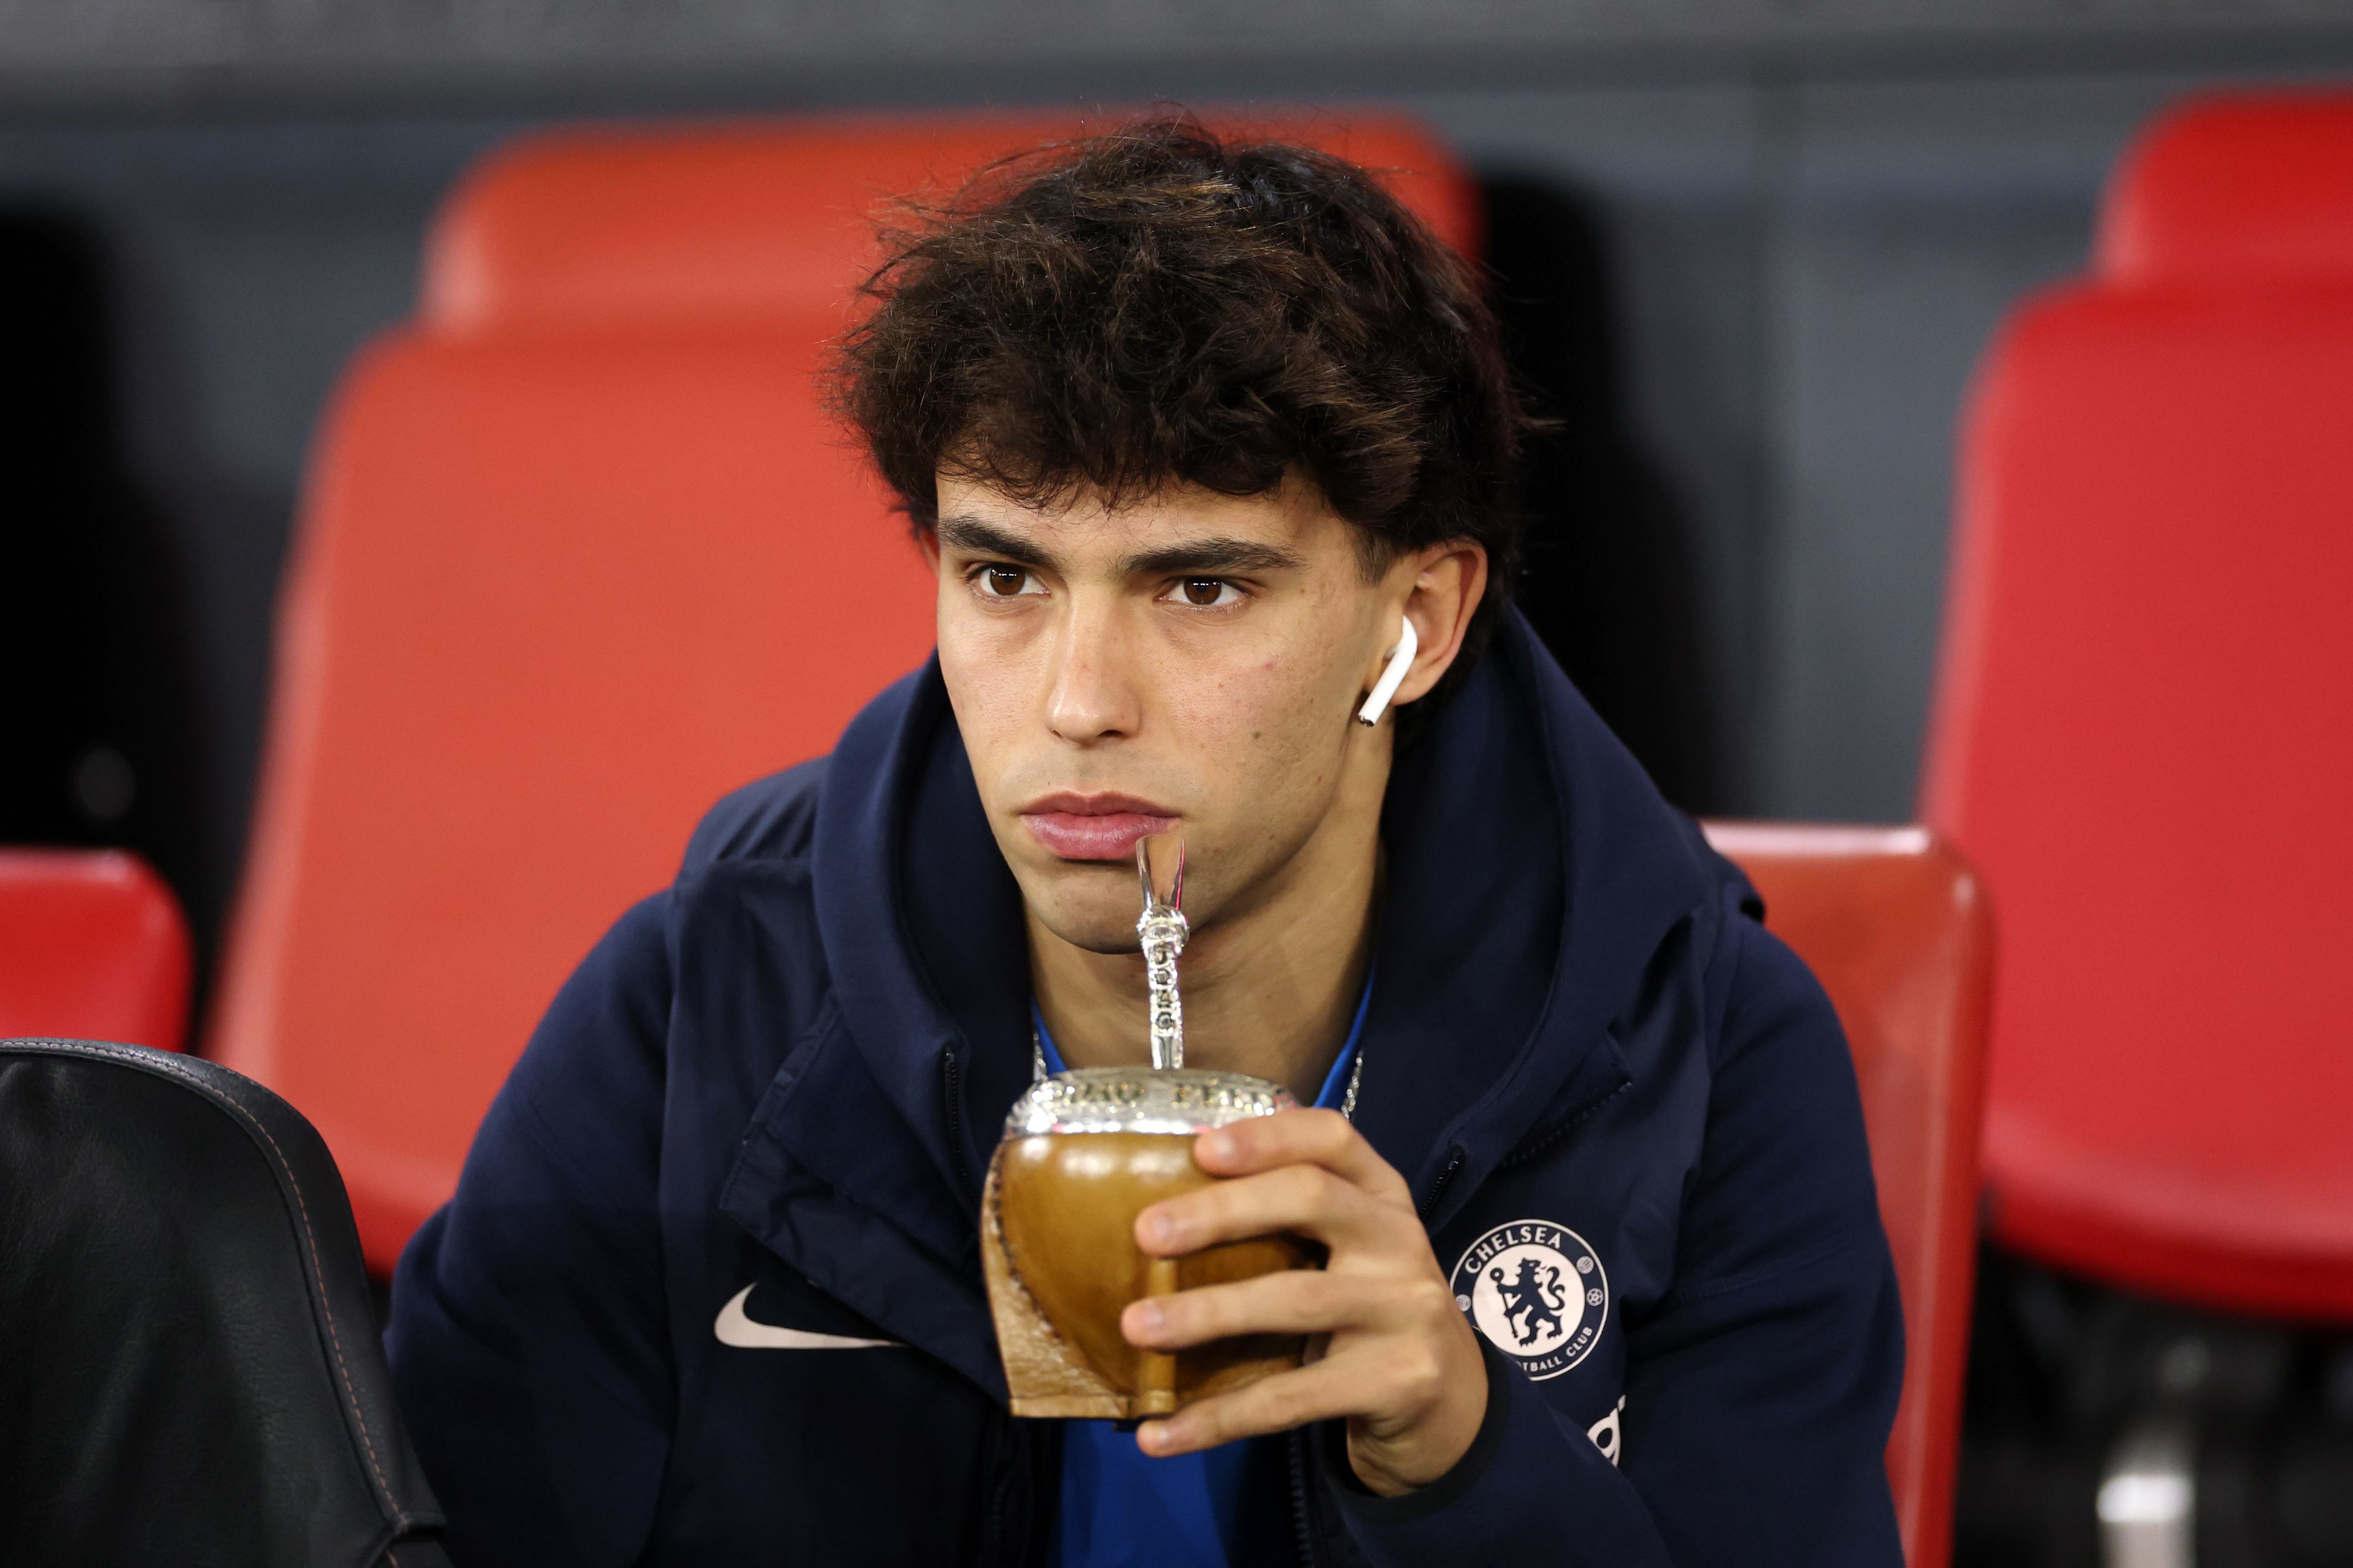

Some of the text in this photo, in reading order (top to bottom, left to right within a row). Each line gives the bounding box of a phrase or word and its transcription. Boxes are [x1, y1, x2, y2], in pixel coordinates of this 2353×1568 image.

[1465, 1226, 1562, 1273] CHELSEA
[1516, 1327, 1593, 1372] TBALL CLUB
